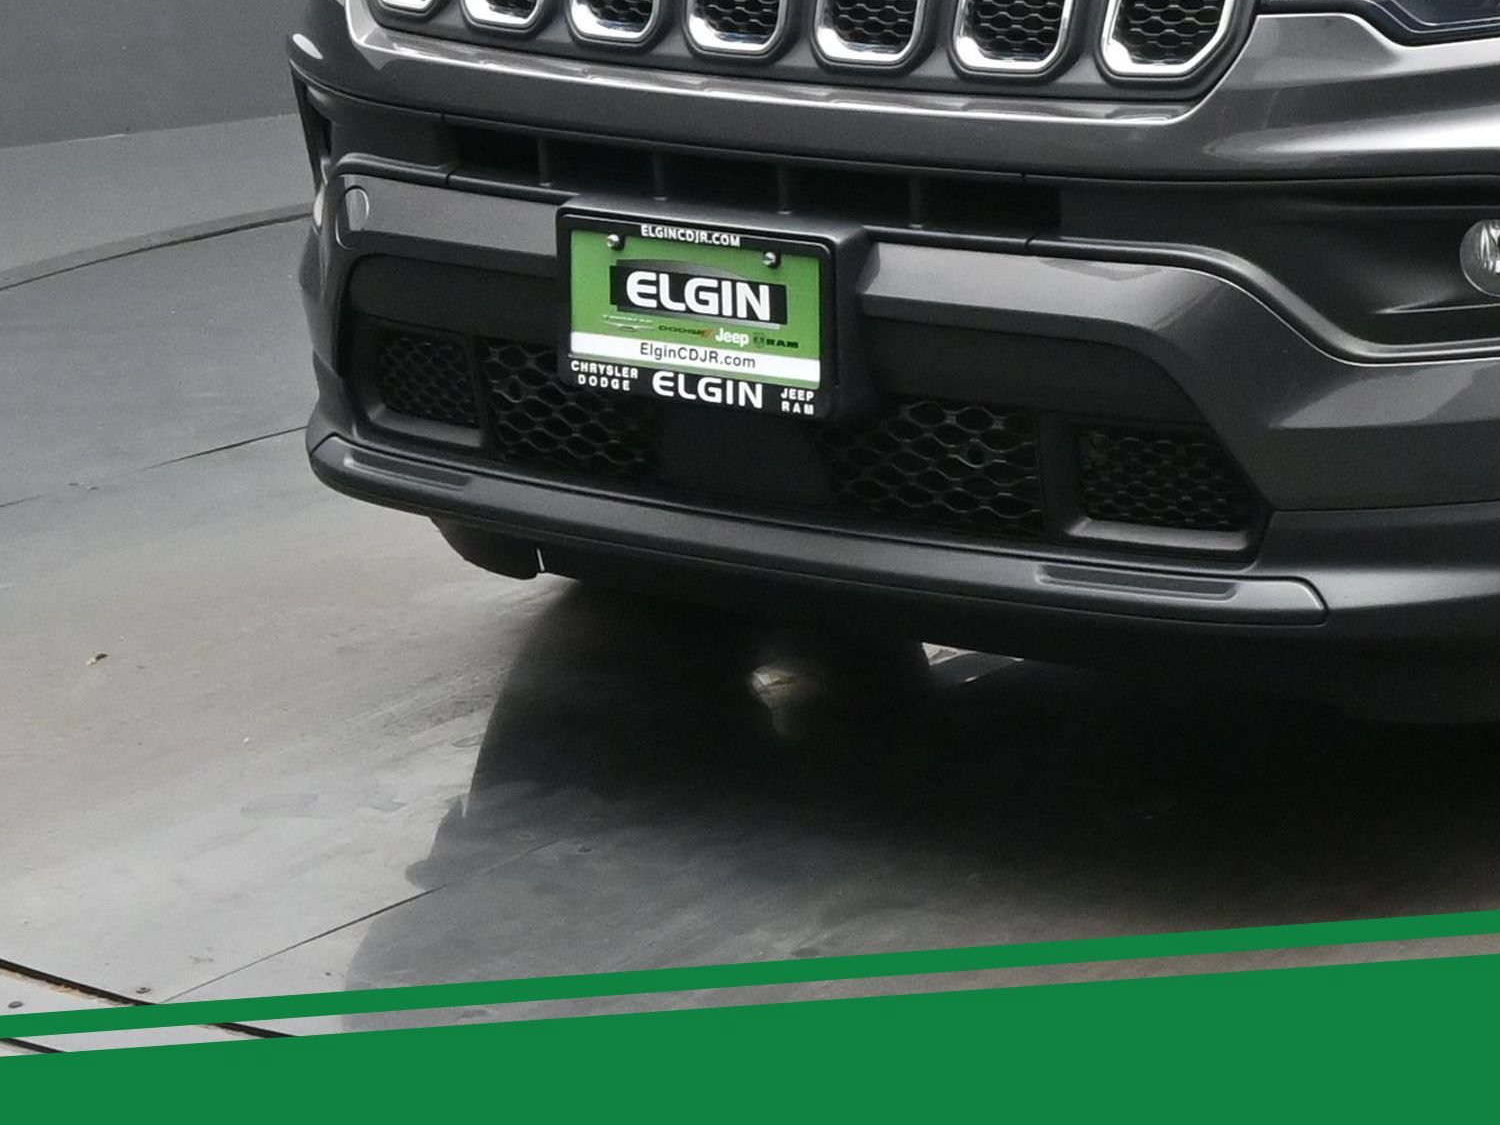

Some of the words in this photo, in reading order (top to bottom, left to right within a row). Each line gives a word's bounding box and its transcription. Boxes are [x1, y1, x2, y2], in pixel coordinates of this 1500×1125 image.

[640, 224, 741, 248] ELGINCDJR.COM
[625, 270, 771, 321] ELGIN
[714, 327, 750, 347] Jeep
[639, 342, 756, 368] ElginCDJR.com
[570, 359, 639, 379] CHRYSLER
[577, 374, 631, 391] DODGE
[651, 370, 764, 409] ELGIN
[780, 387, 815, 402] JEEP
[781, 401, 815, 416] RAM
